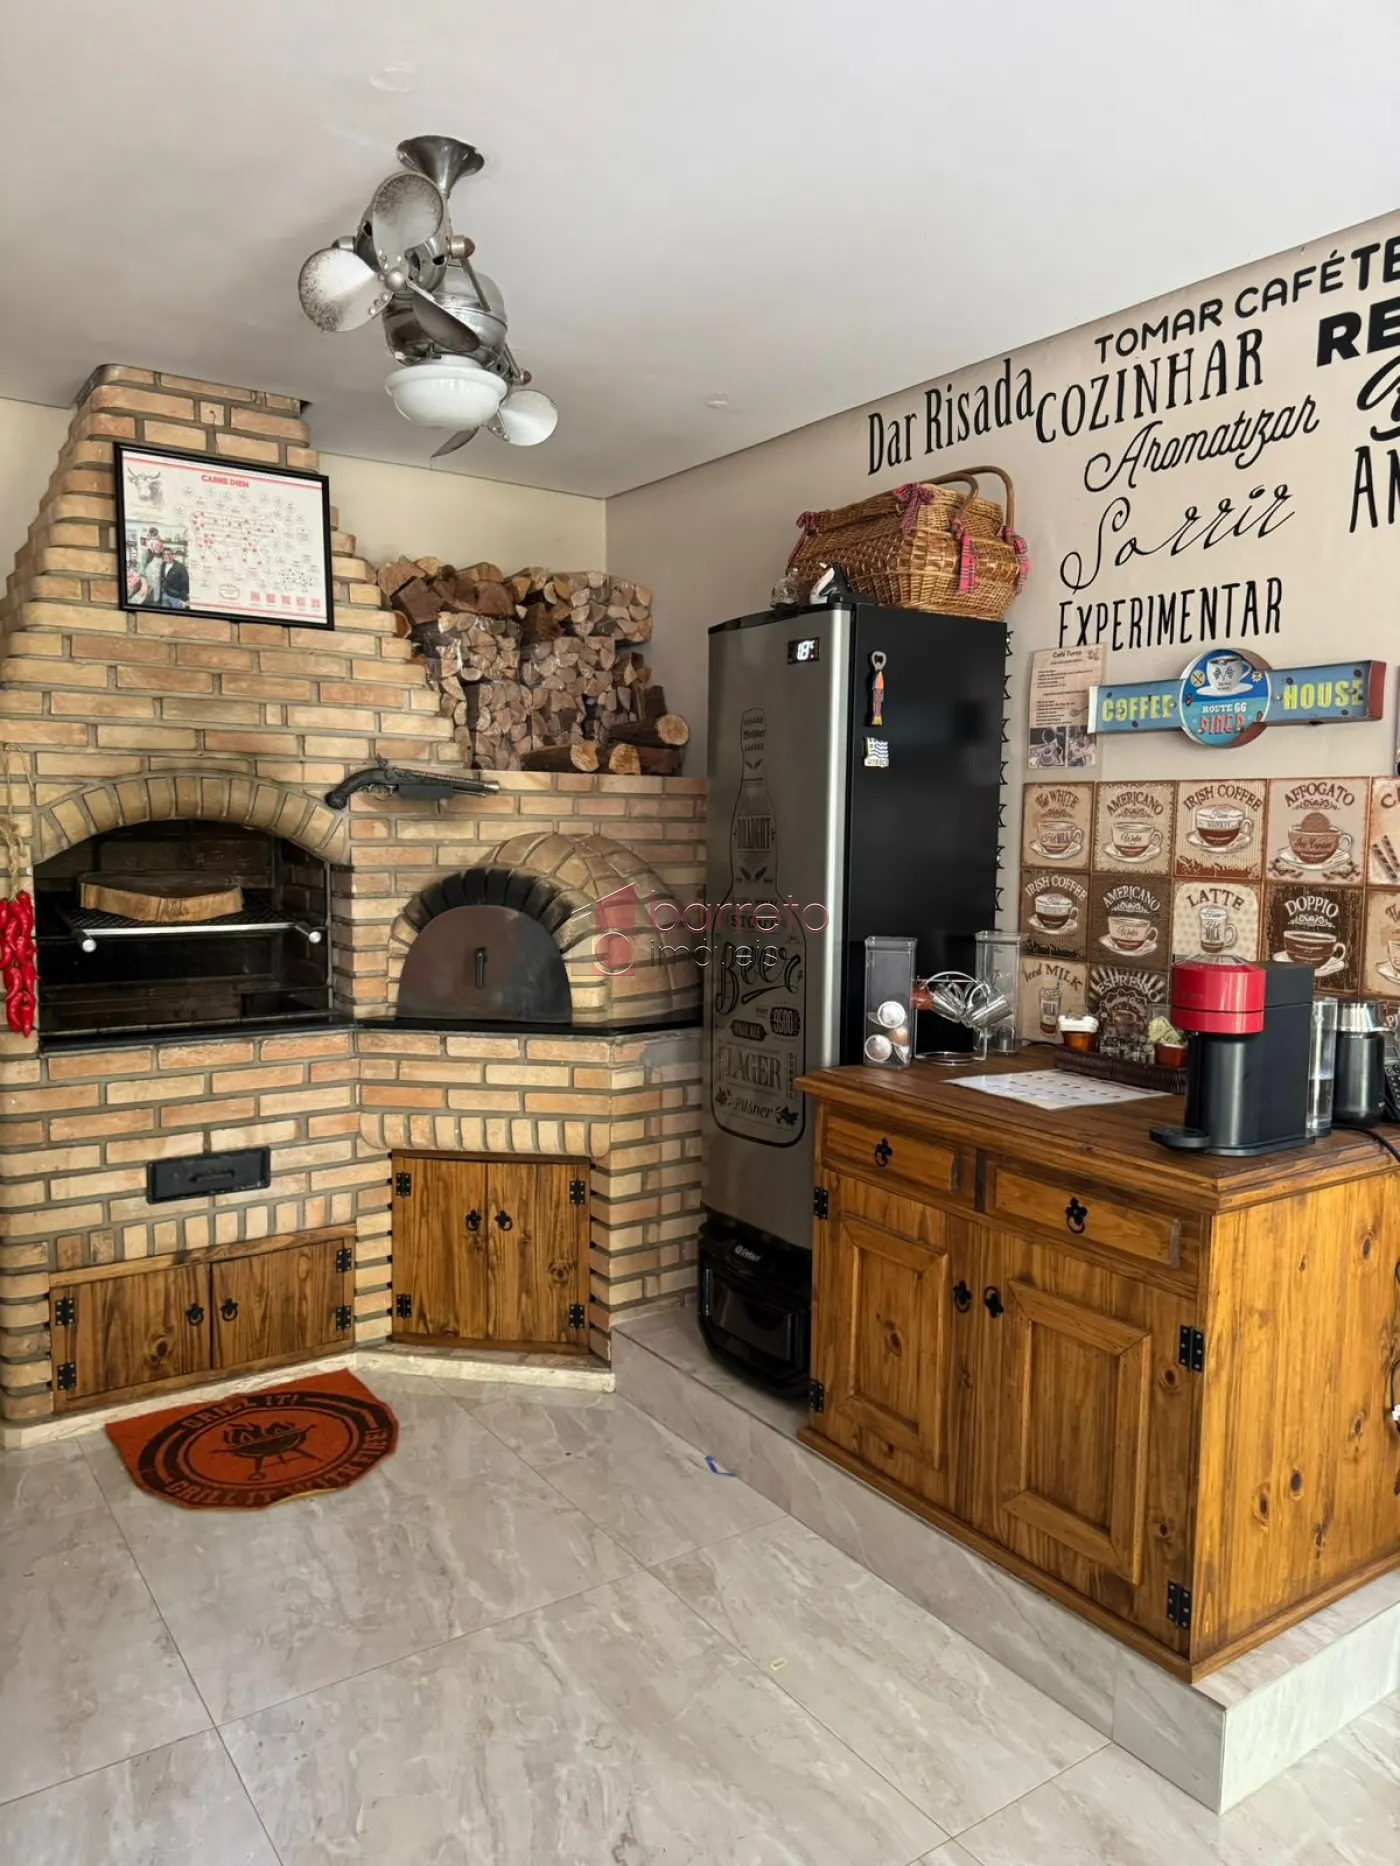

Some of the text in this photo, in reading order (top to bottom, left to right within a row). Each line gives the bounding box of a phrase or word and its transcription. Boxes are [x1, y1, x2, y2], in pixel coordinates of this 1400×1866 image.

[1094, 249, 1345, 363] TOMAR CAFÉ
[1035, 328, 1263, 443] COZINHAR
[868, 358, 1035, 476] Dar Risada
[1084, 394, 1319, 492] Aromatizar
[201, 474, 228, 485] CARNE
[1060, 484, 1295, 595] Sorrir
[1058, 577, 1282, 651] EXPERIMENTAR
[1102, 694, 1173, 721] COFFEE
[1283, 679, 1363, 710] HOUSE
[1202, 701, 1247, 714] ROUTE 66
[1049, 789, 1080, 809] WHITE
[1106, 792, 1164, 815] AMERICANO
[1183, 784, 1263, 812] IRISH COFFEE
[1284, 782, 1355, 807] AFFOGATO
[1025, 875, 1088, 901] IRISH COFFEE
[1103, 885, 1160, 911] AMERICANO
[1186, 888, 1245, 911] LATTE
[1284, 895, 1339, 918] DOPPIO
[714, 941, 801, 1015] Beer
[1045, 964, 1083, 991] MILK
[1097, 974, 1160, 1003] ESPRESSO
[725, 1047, 782, 1090] LAGER
[733, 1096, 774, 1118] Pilsner
